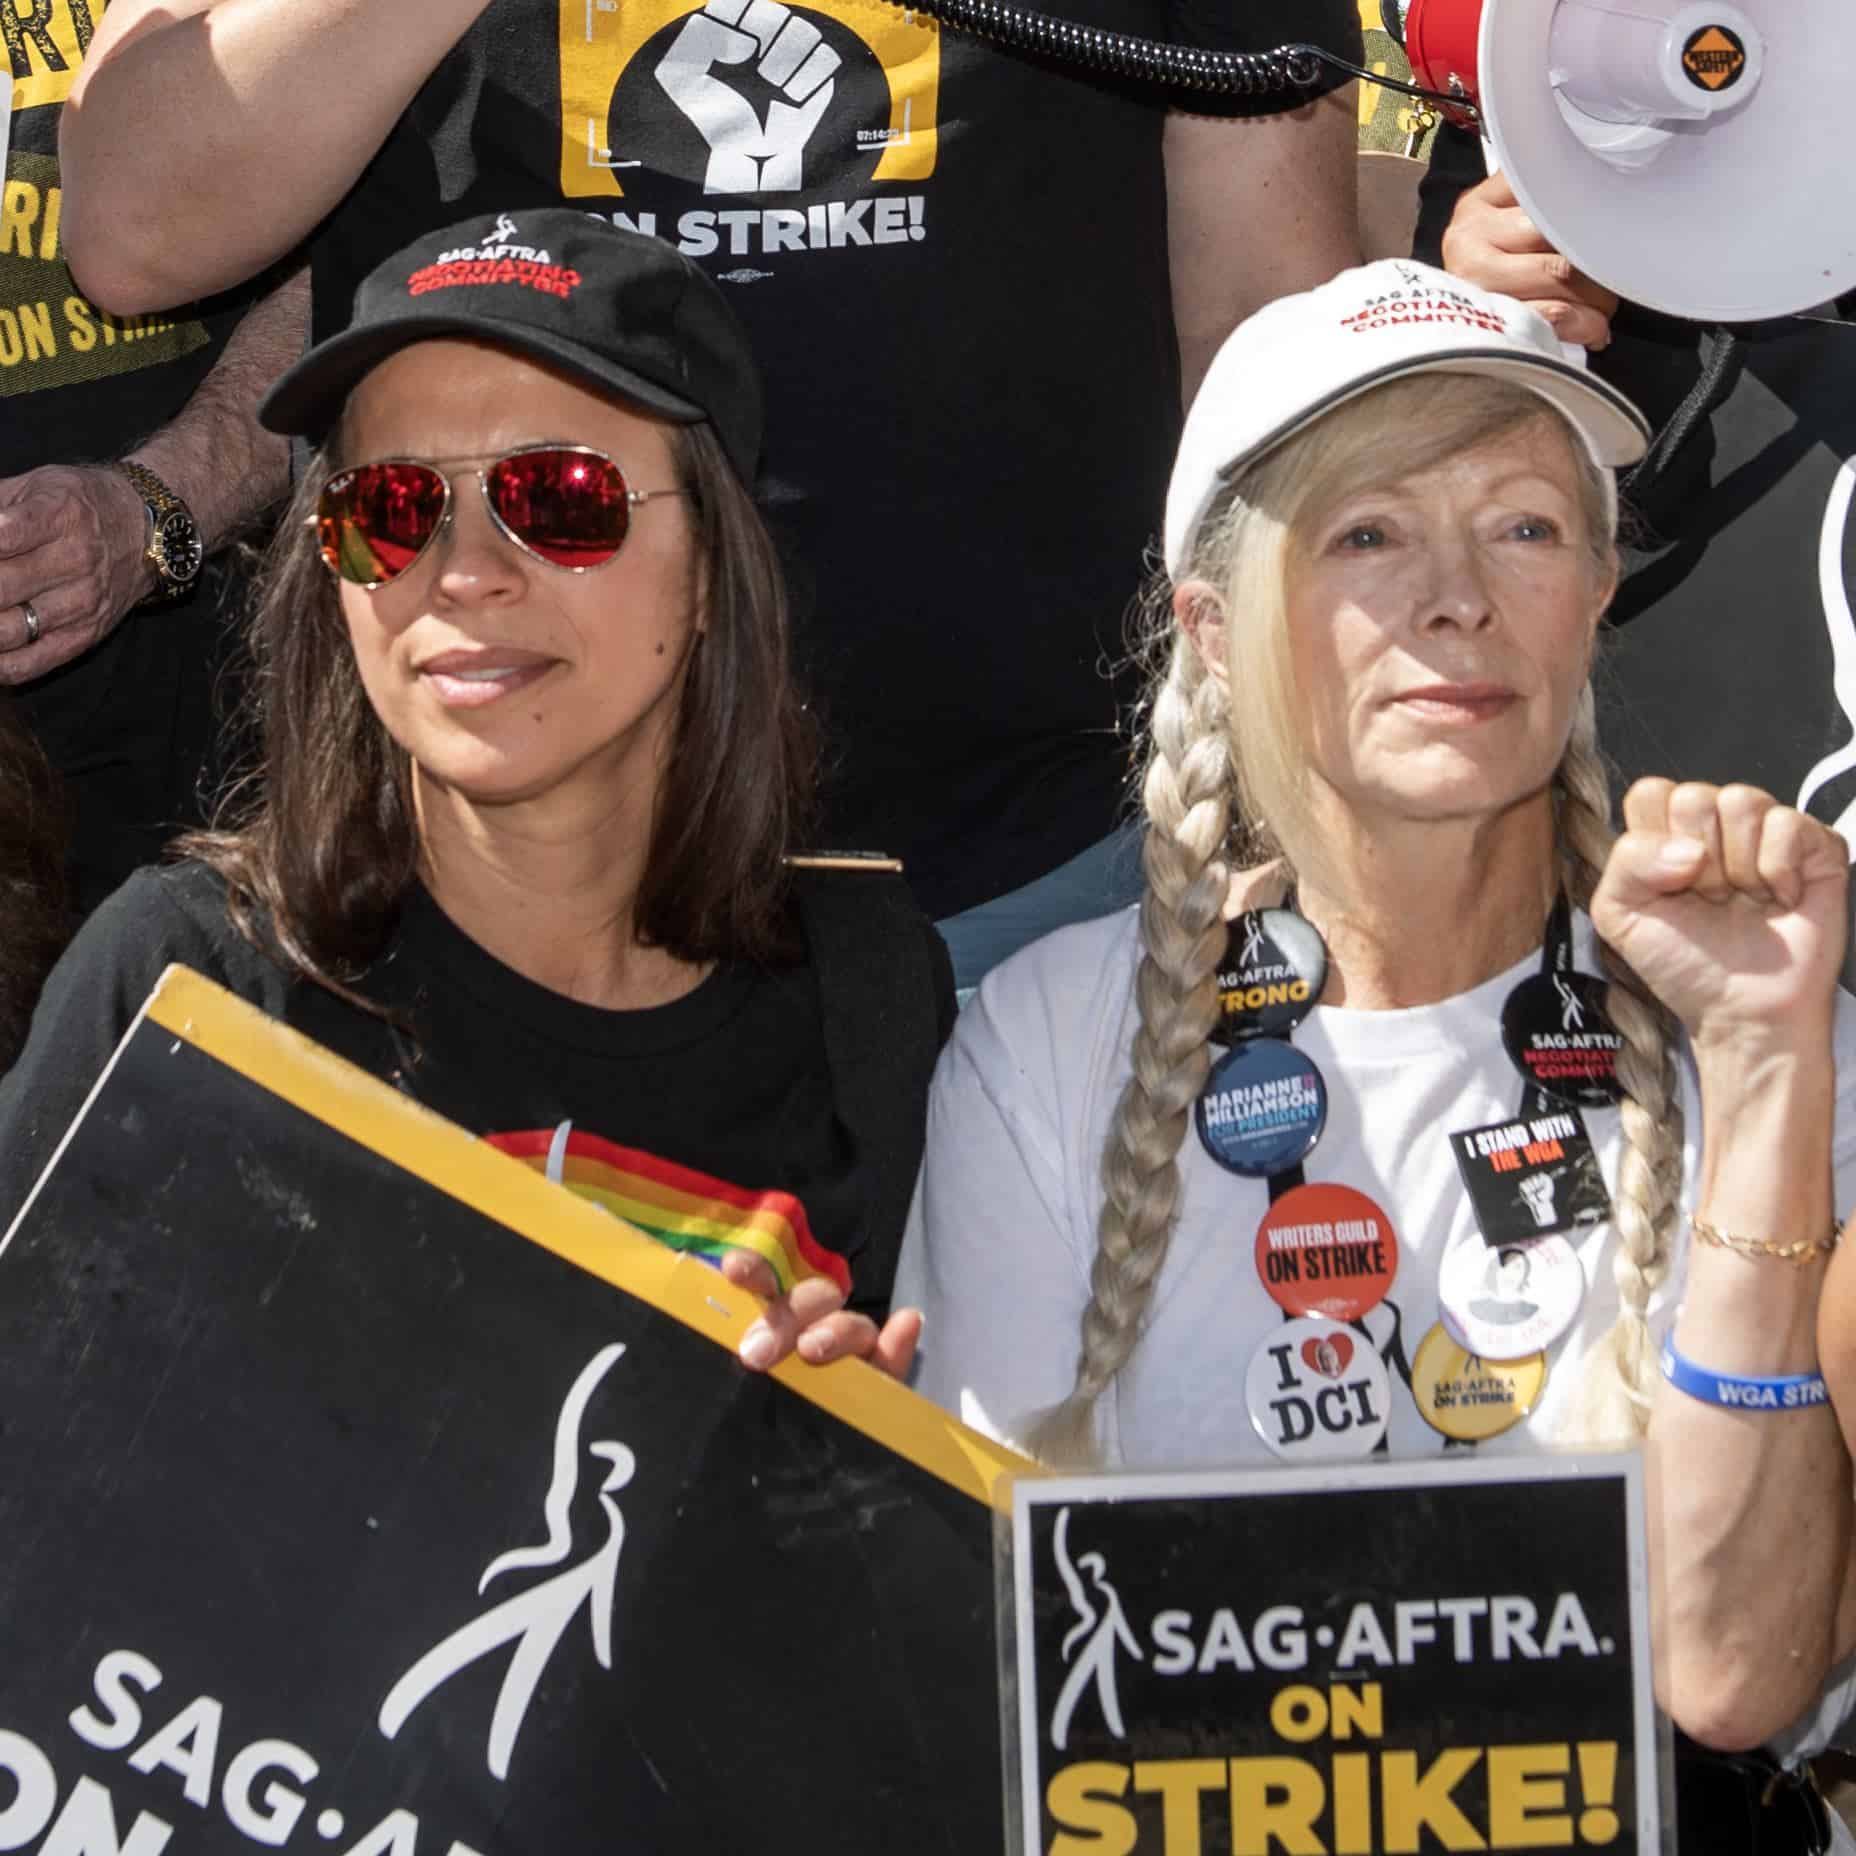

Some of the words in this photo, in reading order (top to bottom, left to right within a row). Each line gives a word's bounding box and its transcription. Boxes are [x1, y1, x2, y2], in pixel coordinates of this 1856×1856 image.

[676, 195, 927, 257] STRIKE!
[1339, 300, 1508, 326] NEGOTIATING
[1352, 314, 1506, 334] COMMITTEE
[1204, 1076, 1302, 1111] MARIANNE
[1205, 1089, 1319, 1127] WILLIAMSON
[1475, 1126, 1530, 1155] STAND
[1528, 1113, 1577, 1142] WITH
[1489, 1150, 1522, 1173] THE
[1523, 1140, 1565, 1167] WGA
[1268, 1222, 1333, 1249] WRITERS
[1335, 1218, 1379, 1244] GUILD
[1266, 1248, 1299, 1284] ON
[1304, 1242, 1387, 1280] STRIKE
[1268, 1343, 1302, 1391] I
[1270, 1378, 1380, 1445] DCI
[1717, 1381, 1778, 1408] WGA
[1271, 1684, 1383, 1741] ON
[1046, 1742, 1620, 1856] STRIKE!
